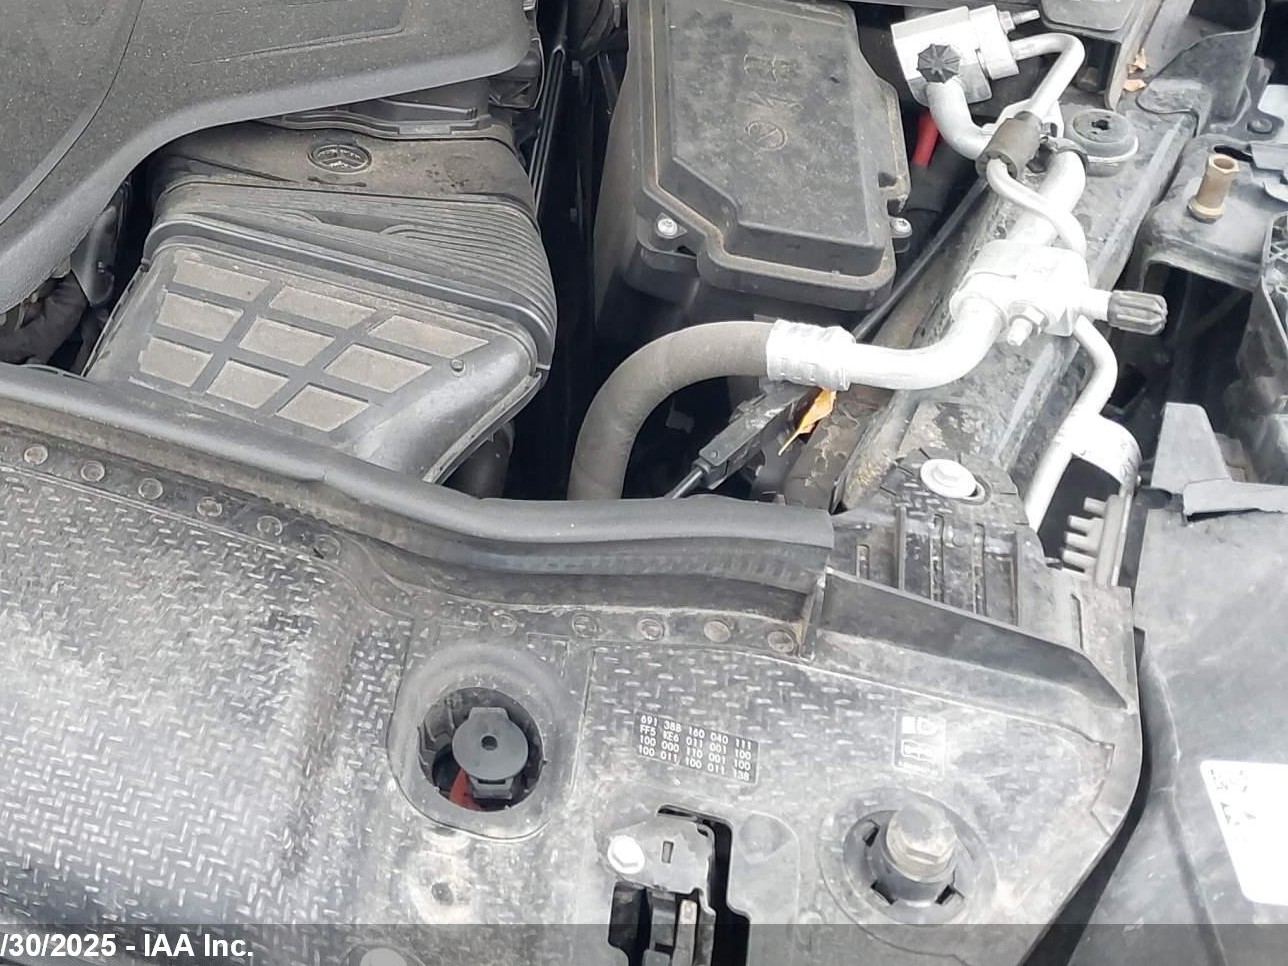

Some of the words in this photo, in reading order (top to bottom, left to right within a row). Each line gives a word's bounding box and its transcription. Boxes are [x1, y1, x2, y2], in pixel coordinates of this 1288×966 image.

[640, 725, 656, 736] FF5
[663, 731, 679, 742] KE6
[686, 737, 703, 748] 011
[709, 743, 726, 754] 001
[735, 749, 751, 760] 100
[641, 714, 657, 726] 691
[689, 727, 705, 738] 160
[710, 733, 728, 744] 040
[736, 738, 751, 750] 111
[638, 745, 655, 756] 100
[660, 751, 678, 762] 011
[685, 757, 702, 769] 100
[707, 762, 725, 774] 011
[640, 735, 656, 746] 100
[661, 741, 679, 752] 000
[686, 746, 703, 758] 110
[708, 752, 725, 764] 001
[734, 759, 751, 770] 100
